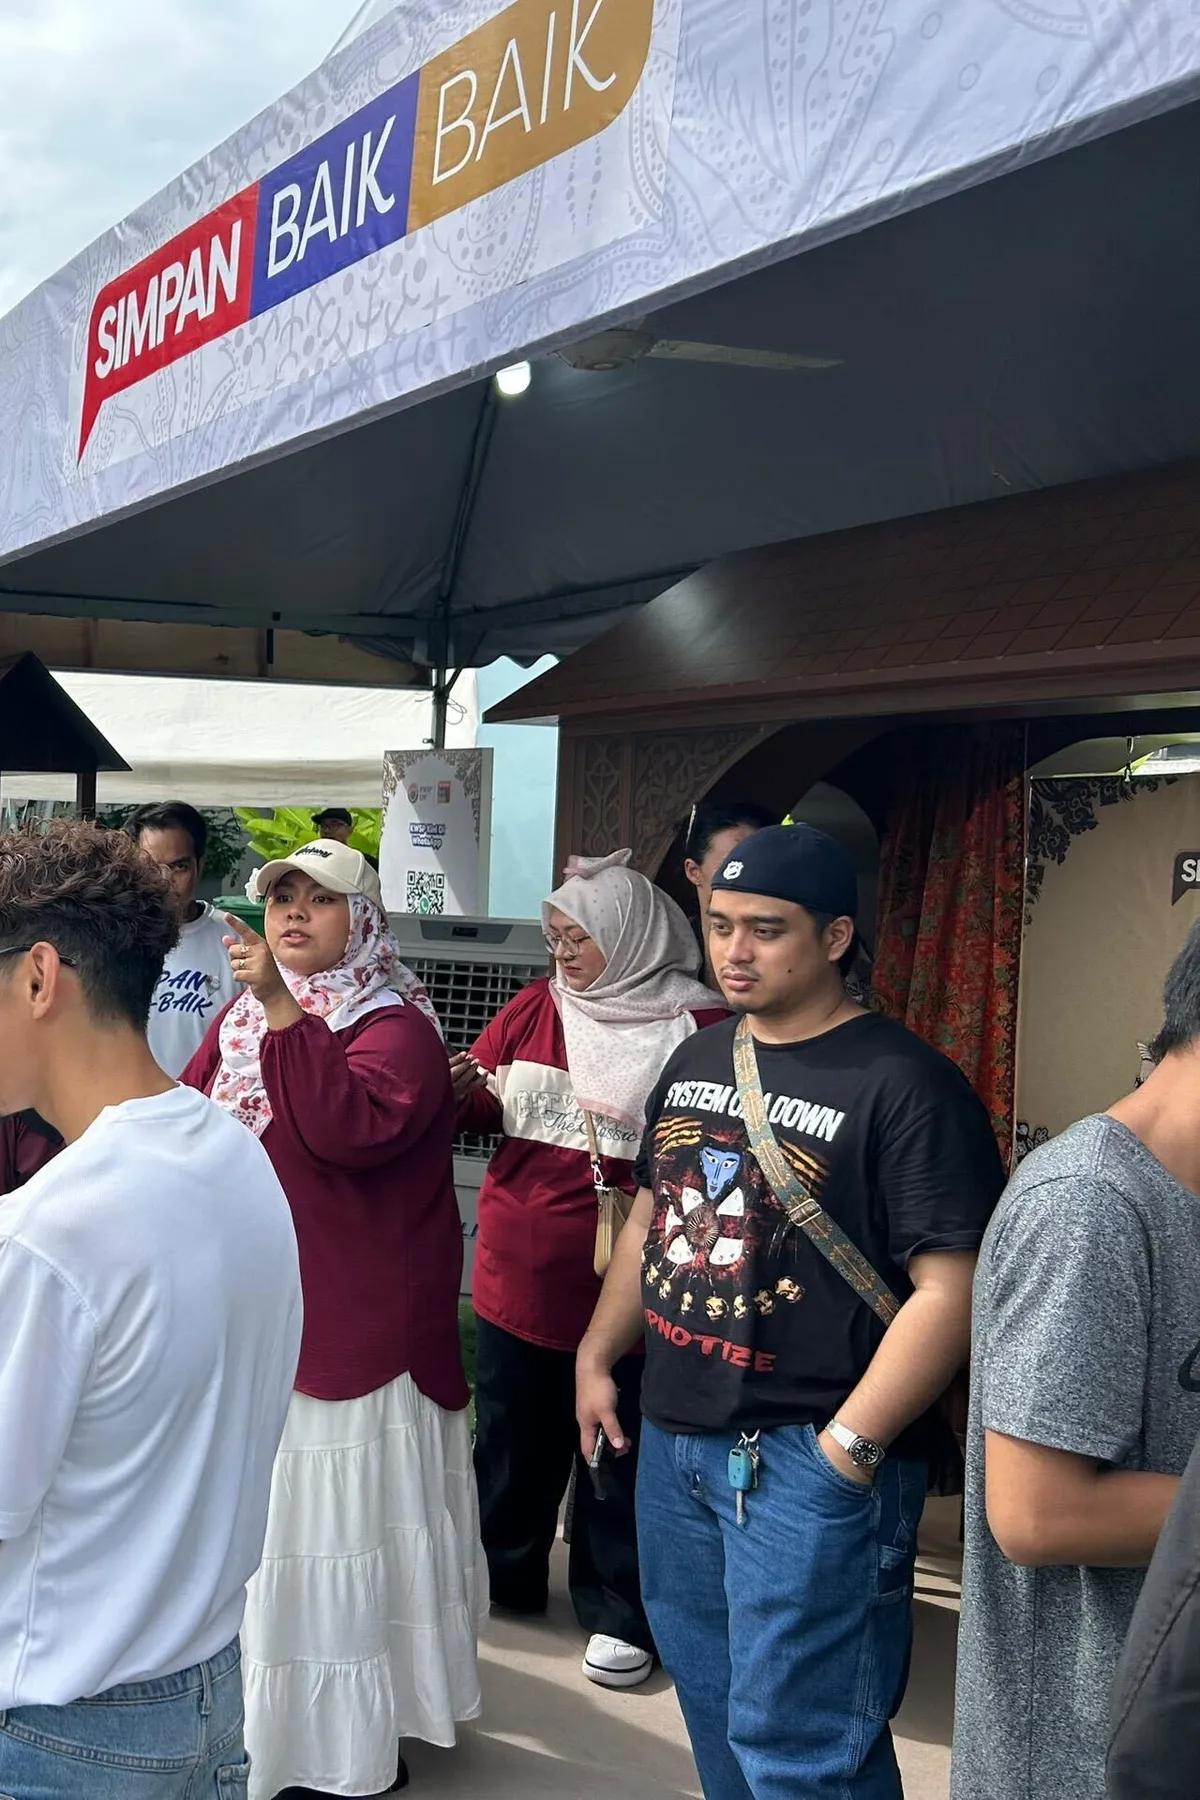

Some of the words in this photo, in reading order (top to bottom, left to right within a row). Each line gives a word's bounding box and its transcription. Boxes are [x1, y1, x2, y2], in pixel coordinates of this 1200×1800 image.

[94, 219, 242, 380] SIMPAN
[267, 114, 397, 279] BAIK
[432, 0, 616, 186] BAIK
[154, 969, 208, 992] PAN
[544, 1109, 576, 1132] The
[664, 1080, 733, 1114] SYSTEM
[769, 1094, 846, 1142] DOWN
[644, 1307, 777, 1373] PNOTIZE
